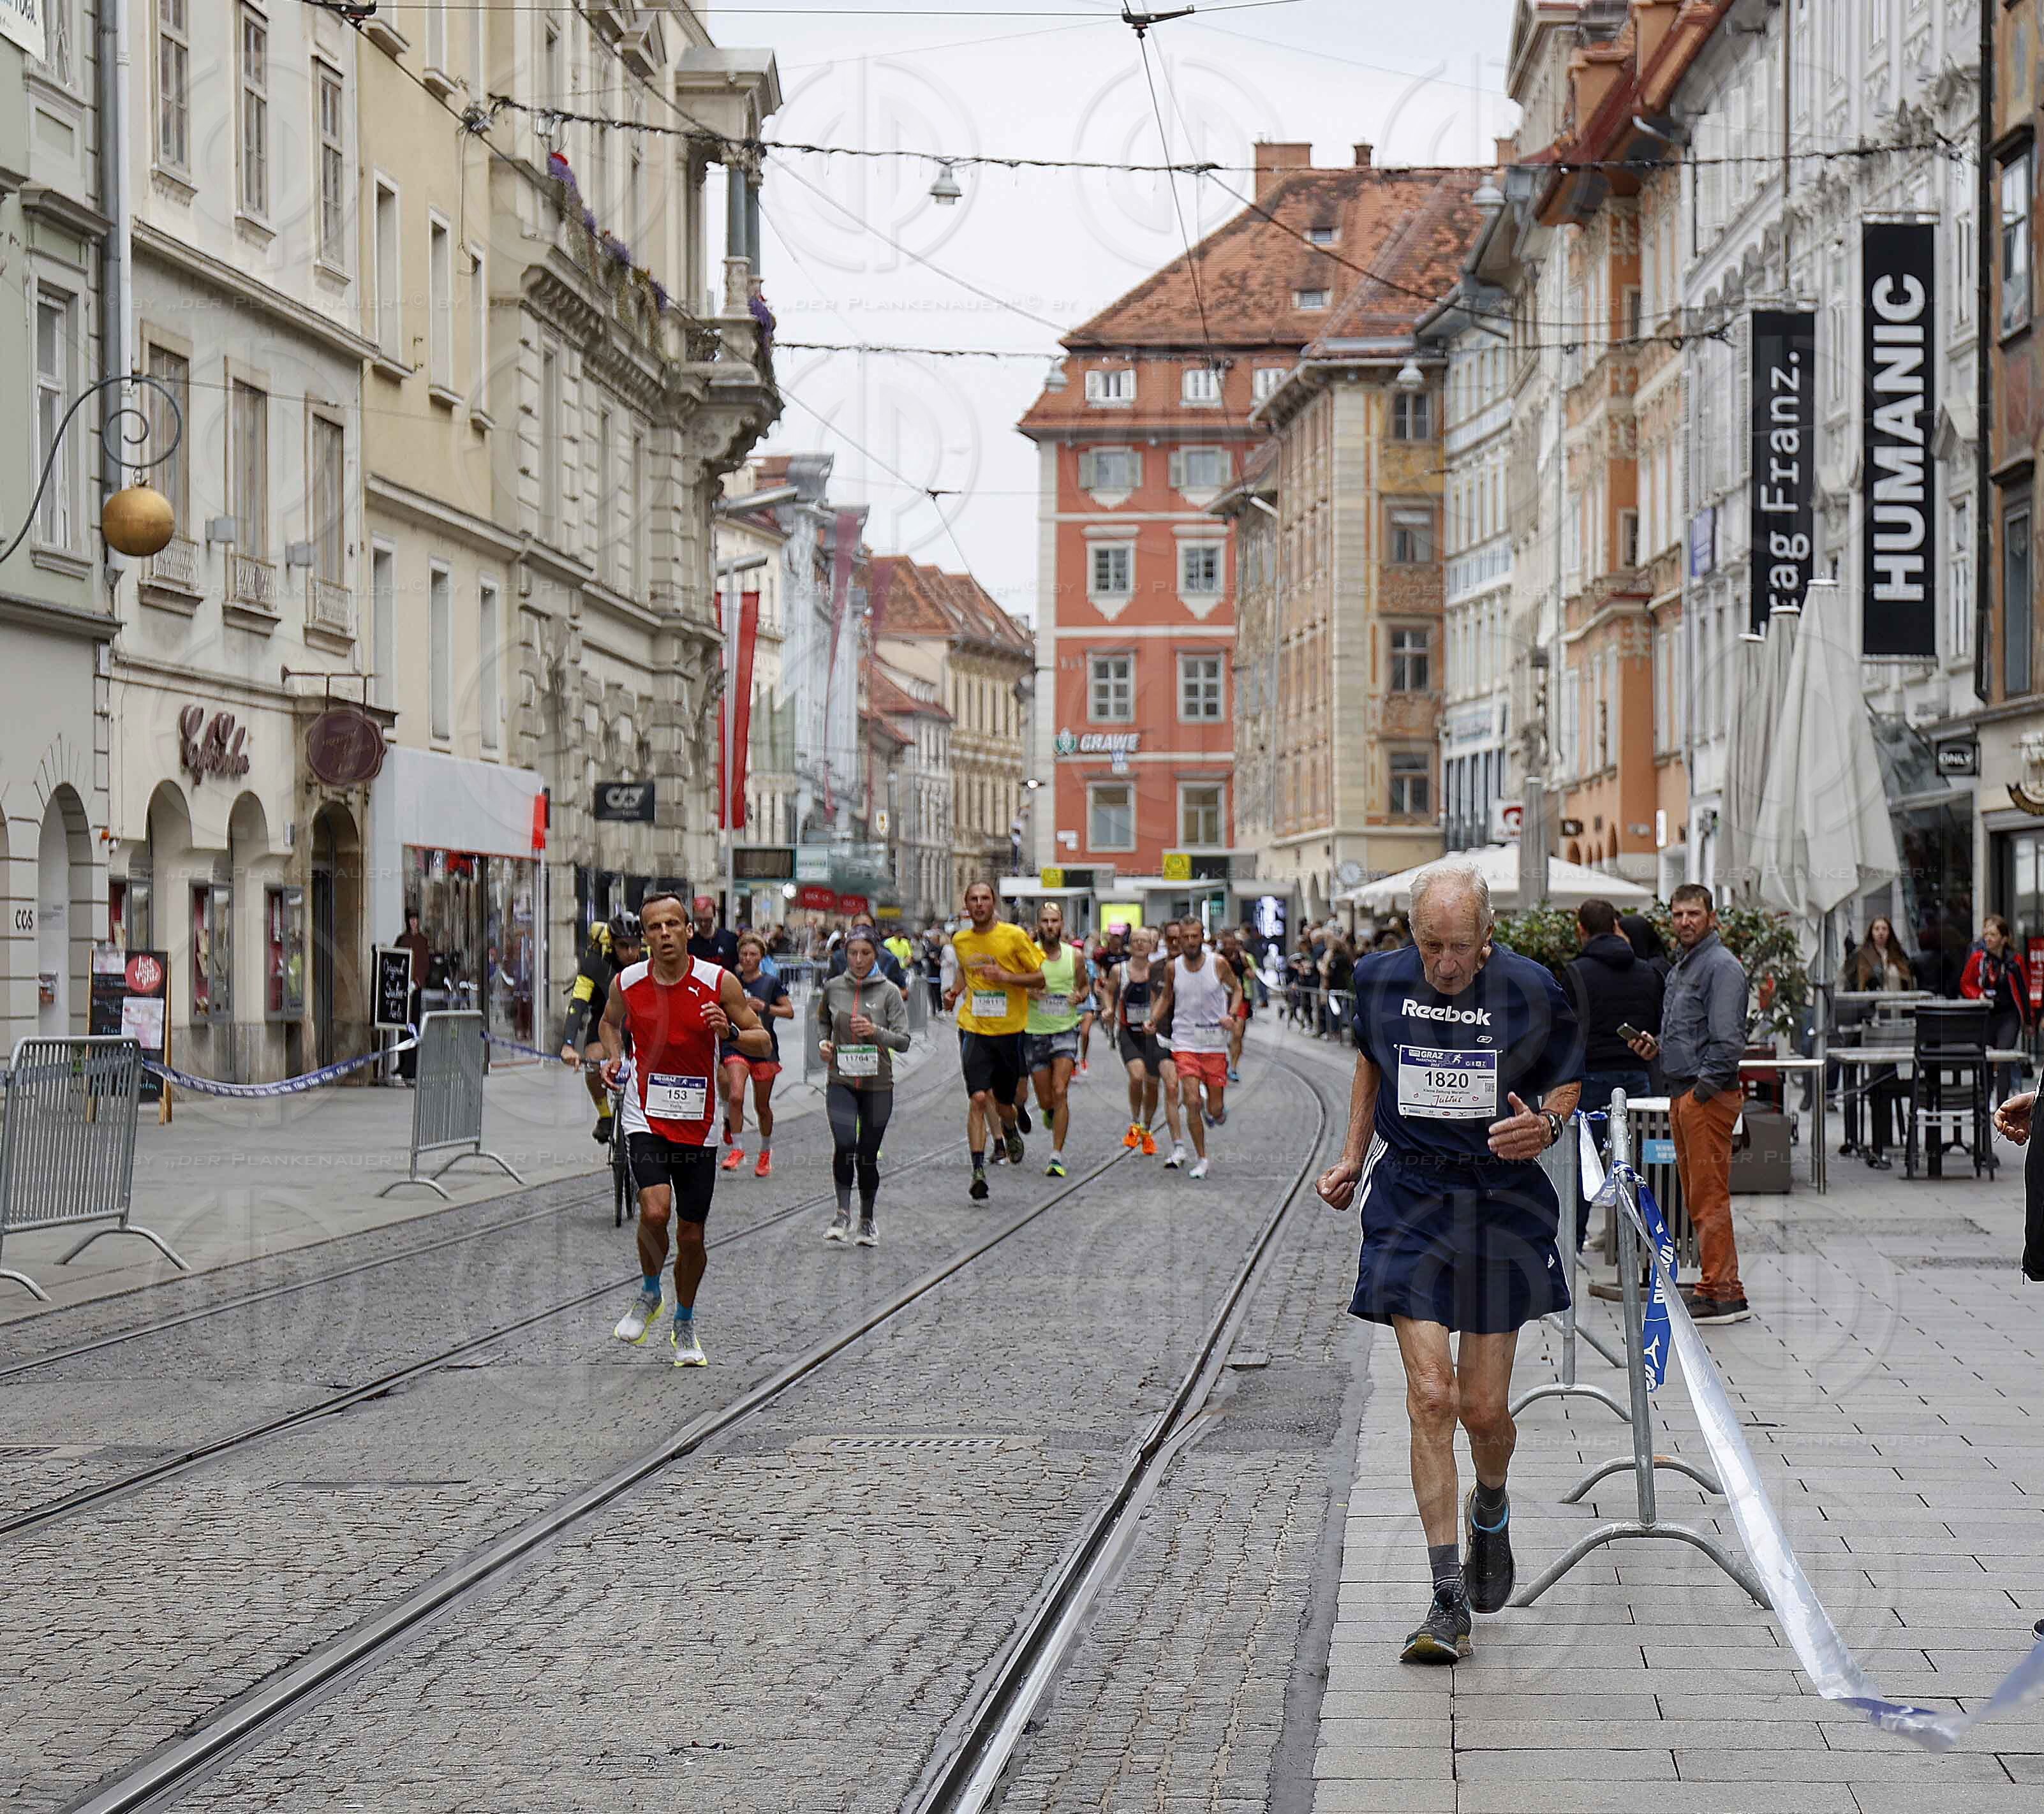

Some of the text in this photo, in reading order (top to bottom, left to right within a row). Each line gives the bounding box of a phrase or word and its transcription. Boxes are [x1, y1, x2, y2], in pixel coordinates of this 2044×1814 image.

[1760, 351, 1800, 512] Franz.
[1872, 273, 1925, 601] HUMANIC
[1402, 998, 1492, 1026] Reebok
[1421, 1051, 1444, 1059] GRAZ
[1425, 1071, 1469, 1089] 1820
[667, 1089, 687, 1100] 153
